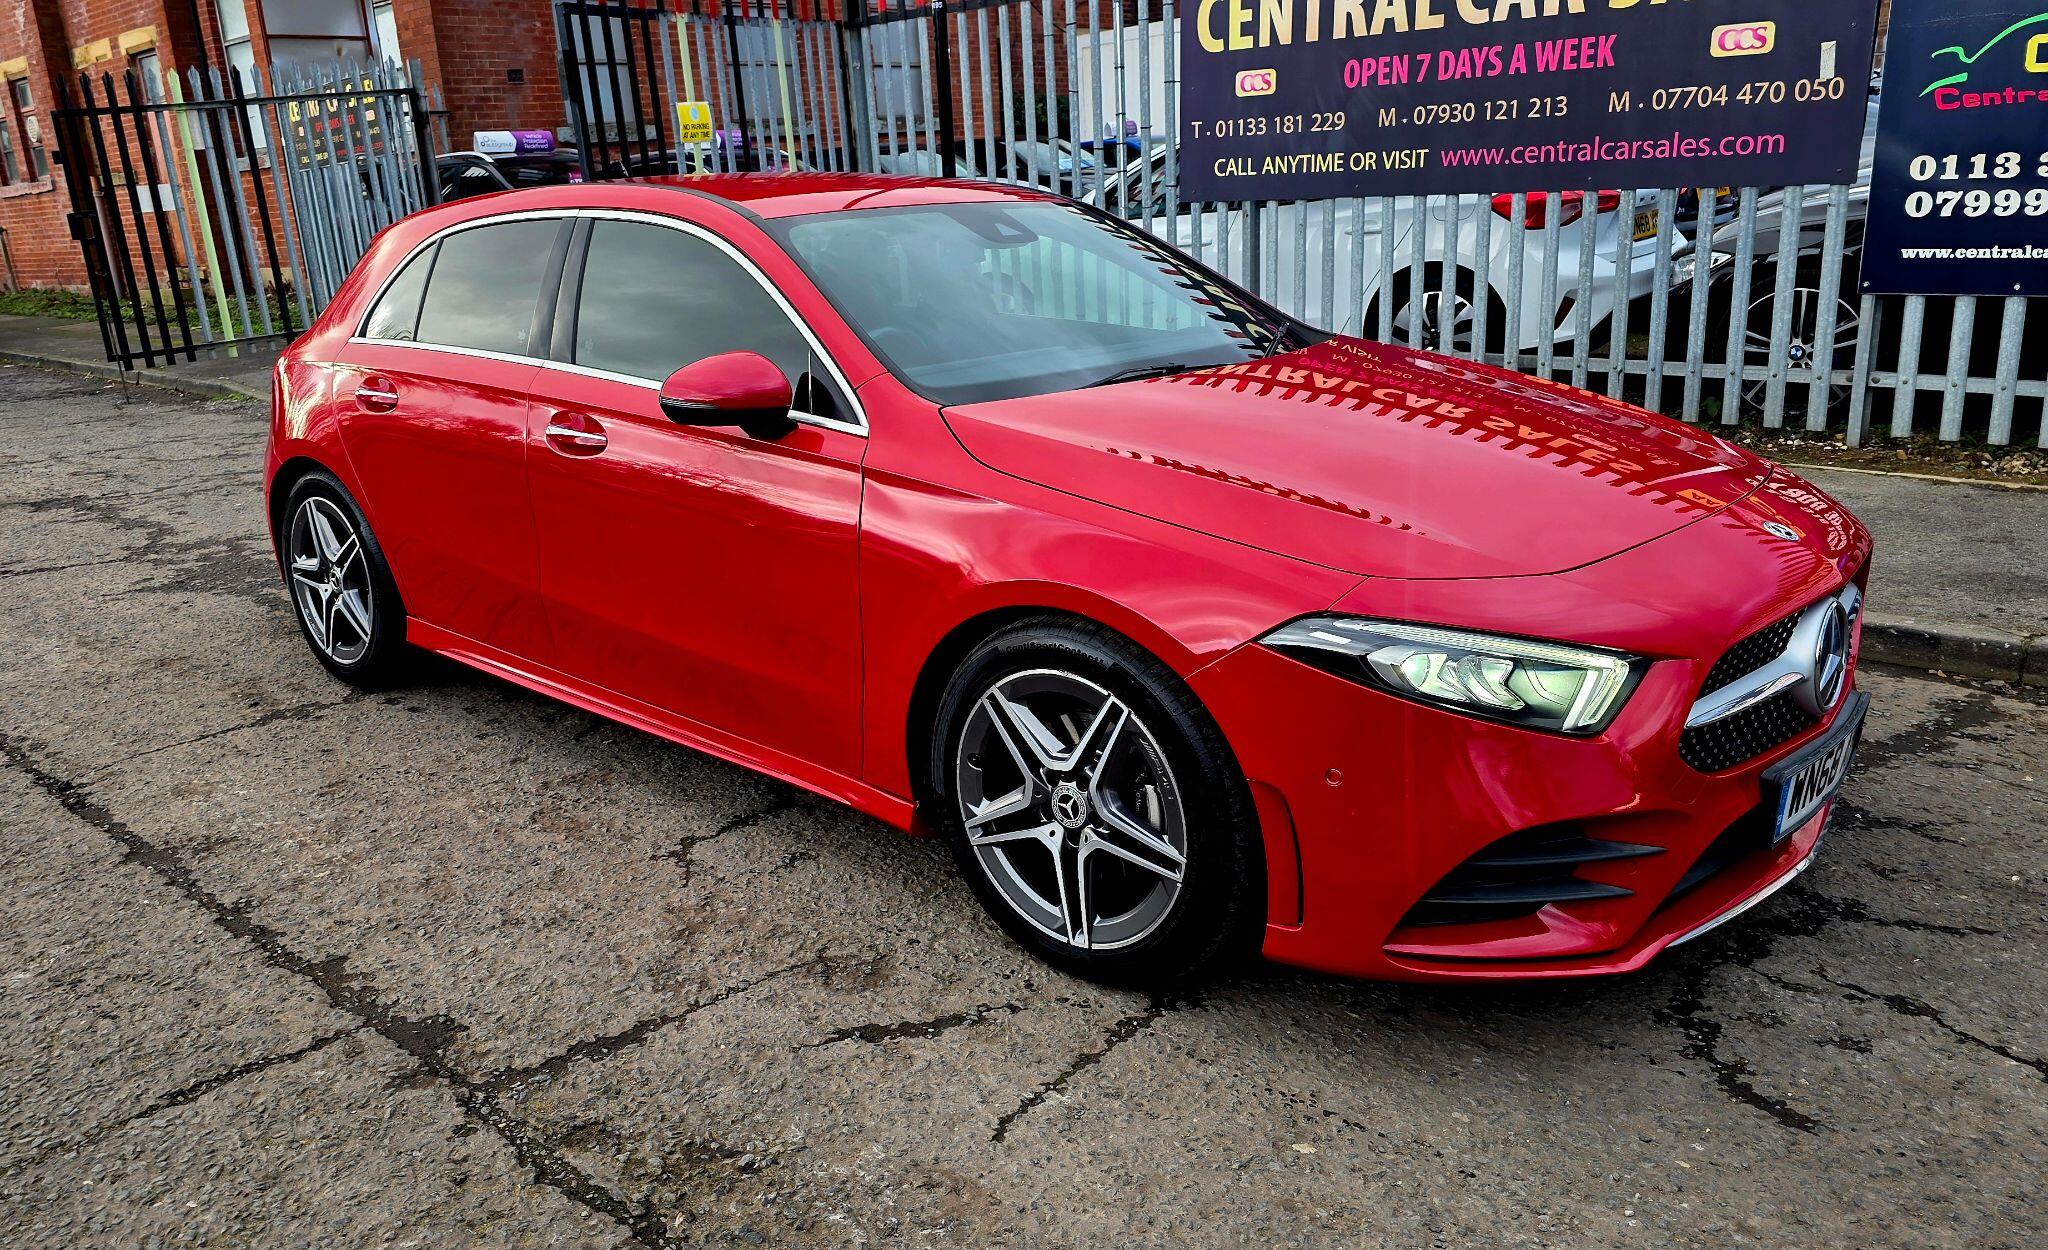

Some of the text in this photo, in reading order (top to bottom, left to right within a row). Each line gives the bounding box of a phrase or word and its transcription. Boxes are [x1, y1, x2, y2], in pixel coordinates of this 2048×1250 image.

[1717, 26, 1768, 51] CCS
[1343, 34, 1618, 89] OPEN 7 DAYS A WEEK
[1652, 84, 1729, 111] 07704
[1736, 80, 1786, 105] 470
[1794, 76, 1845, 102] 050
[1215, 117, 1267, 138] 01133
[1274, 114, 1303, 134] 181
[1310, 111, 1346, 132] 229
[1413, 102, 1476, 125] 07930
[1484, 99, 1518, 121] 121
[1527, 95, 1568, 118] 213
[682, 123, 691, 131] NO
[1214, 132, 1785, 177] CALL ANYTIME OR VISIT www.centralcarsales.com
[1909, 151, 2021, 181] 0113
[1904, 188, 2048, 218] 07999
